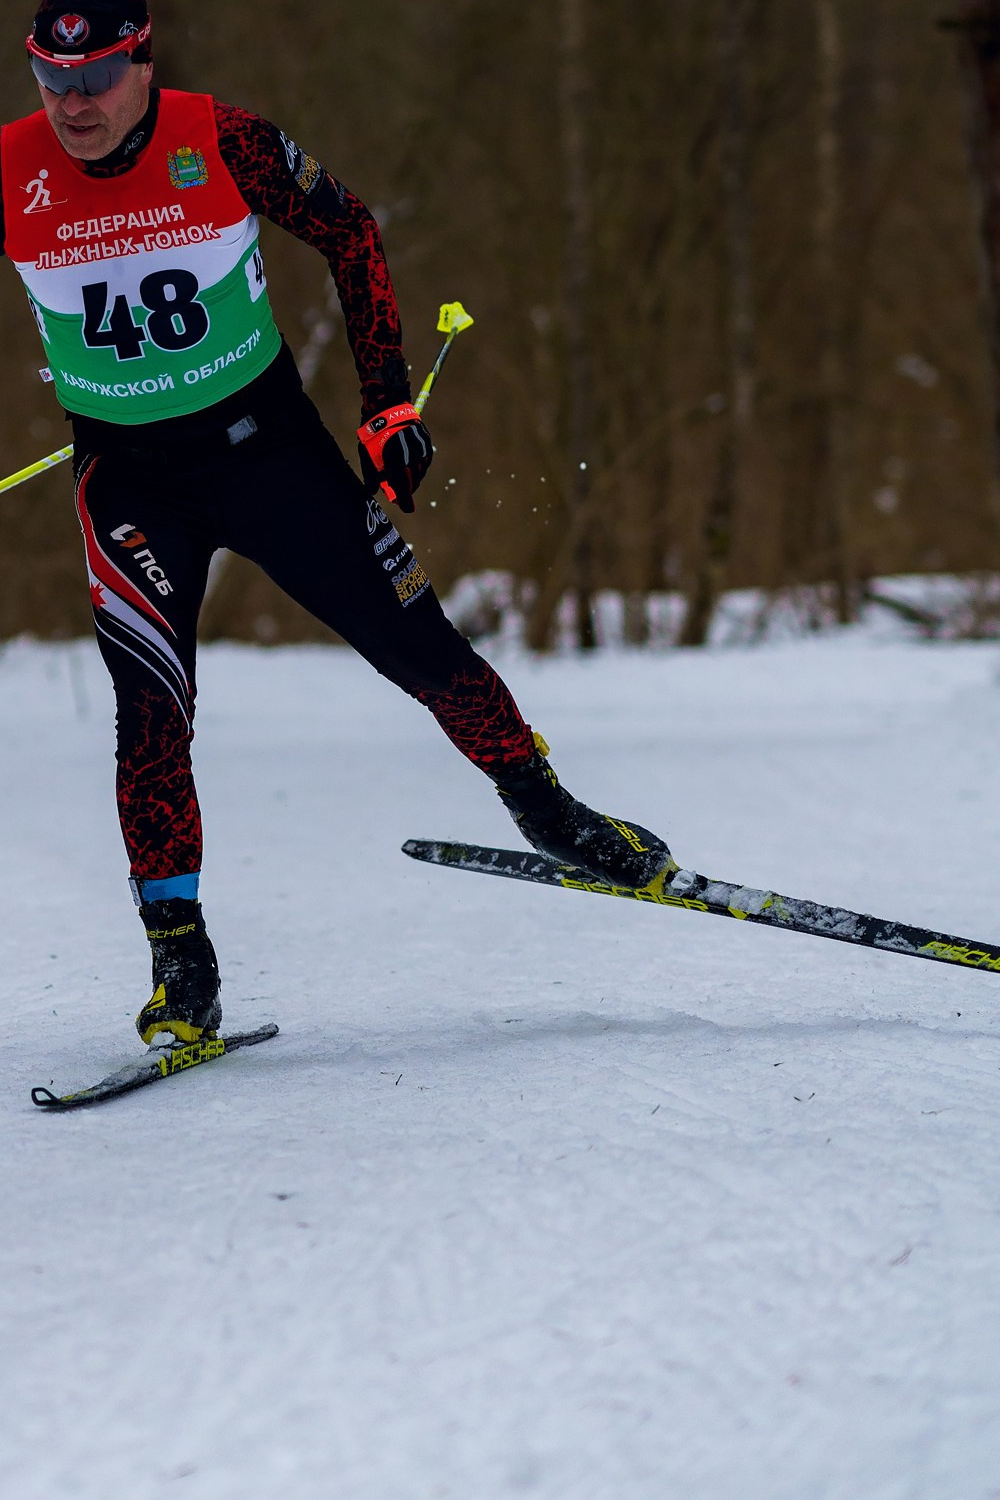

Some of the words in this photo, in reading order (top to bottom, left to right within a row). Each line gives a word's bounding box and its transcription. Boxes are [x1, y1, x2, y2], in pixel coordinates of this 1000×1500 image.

[36, 237, 139, 270] ЛЫЖНЫХ
[143, 222, 221, 251] ГОНОК
[56, 204, 185, 241] ФЕДЕРАЦИЯ
[81, 268, 211, 361] 48
[60, 369, 175, 397] КАЛУЖСКОЙ
[183, 328, 262, 385] ОБЛАСТИ
[133, 548, 174, 596] ПСБ
[561, 878, 709, 912] FISCHER
[171, 1039, 225, 1073] FISCHER
